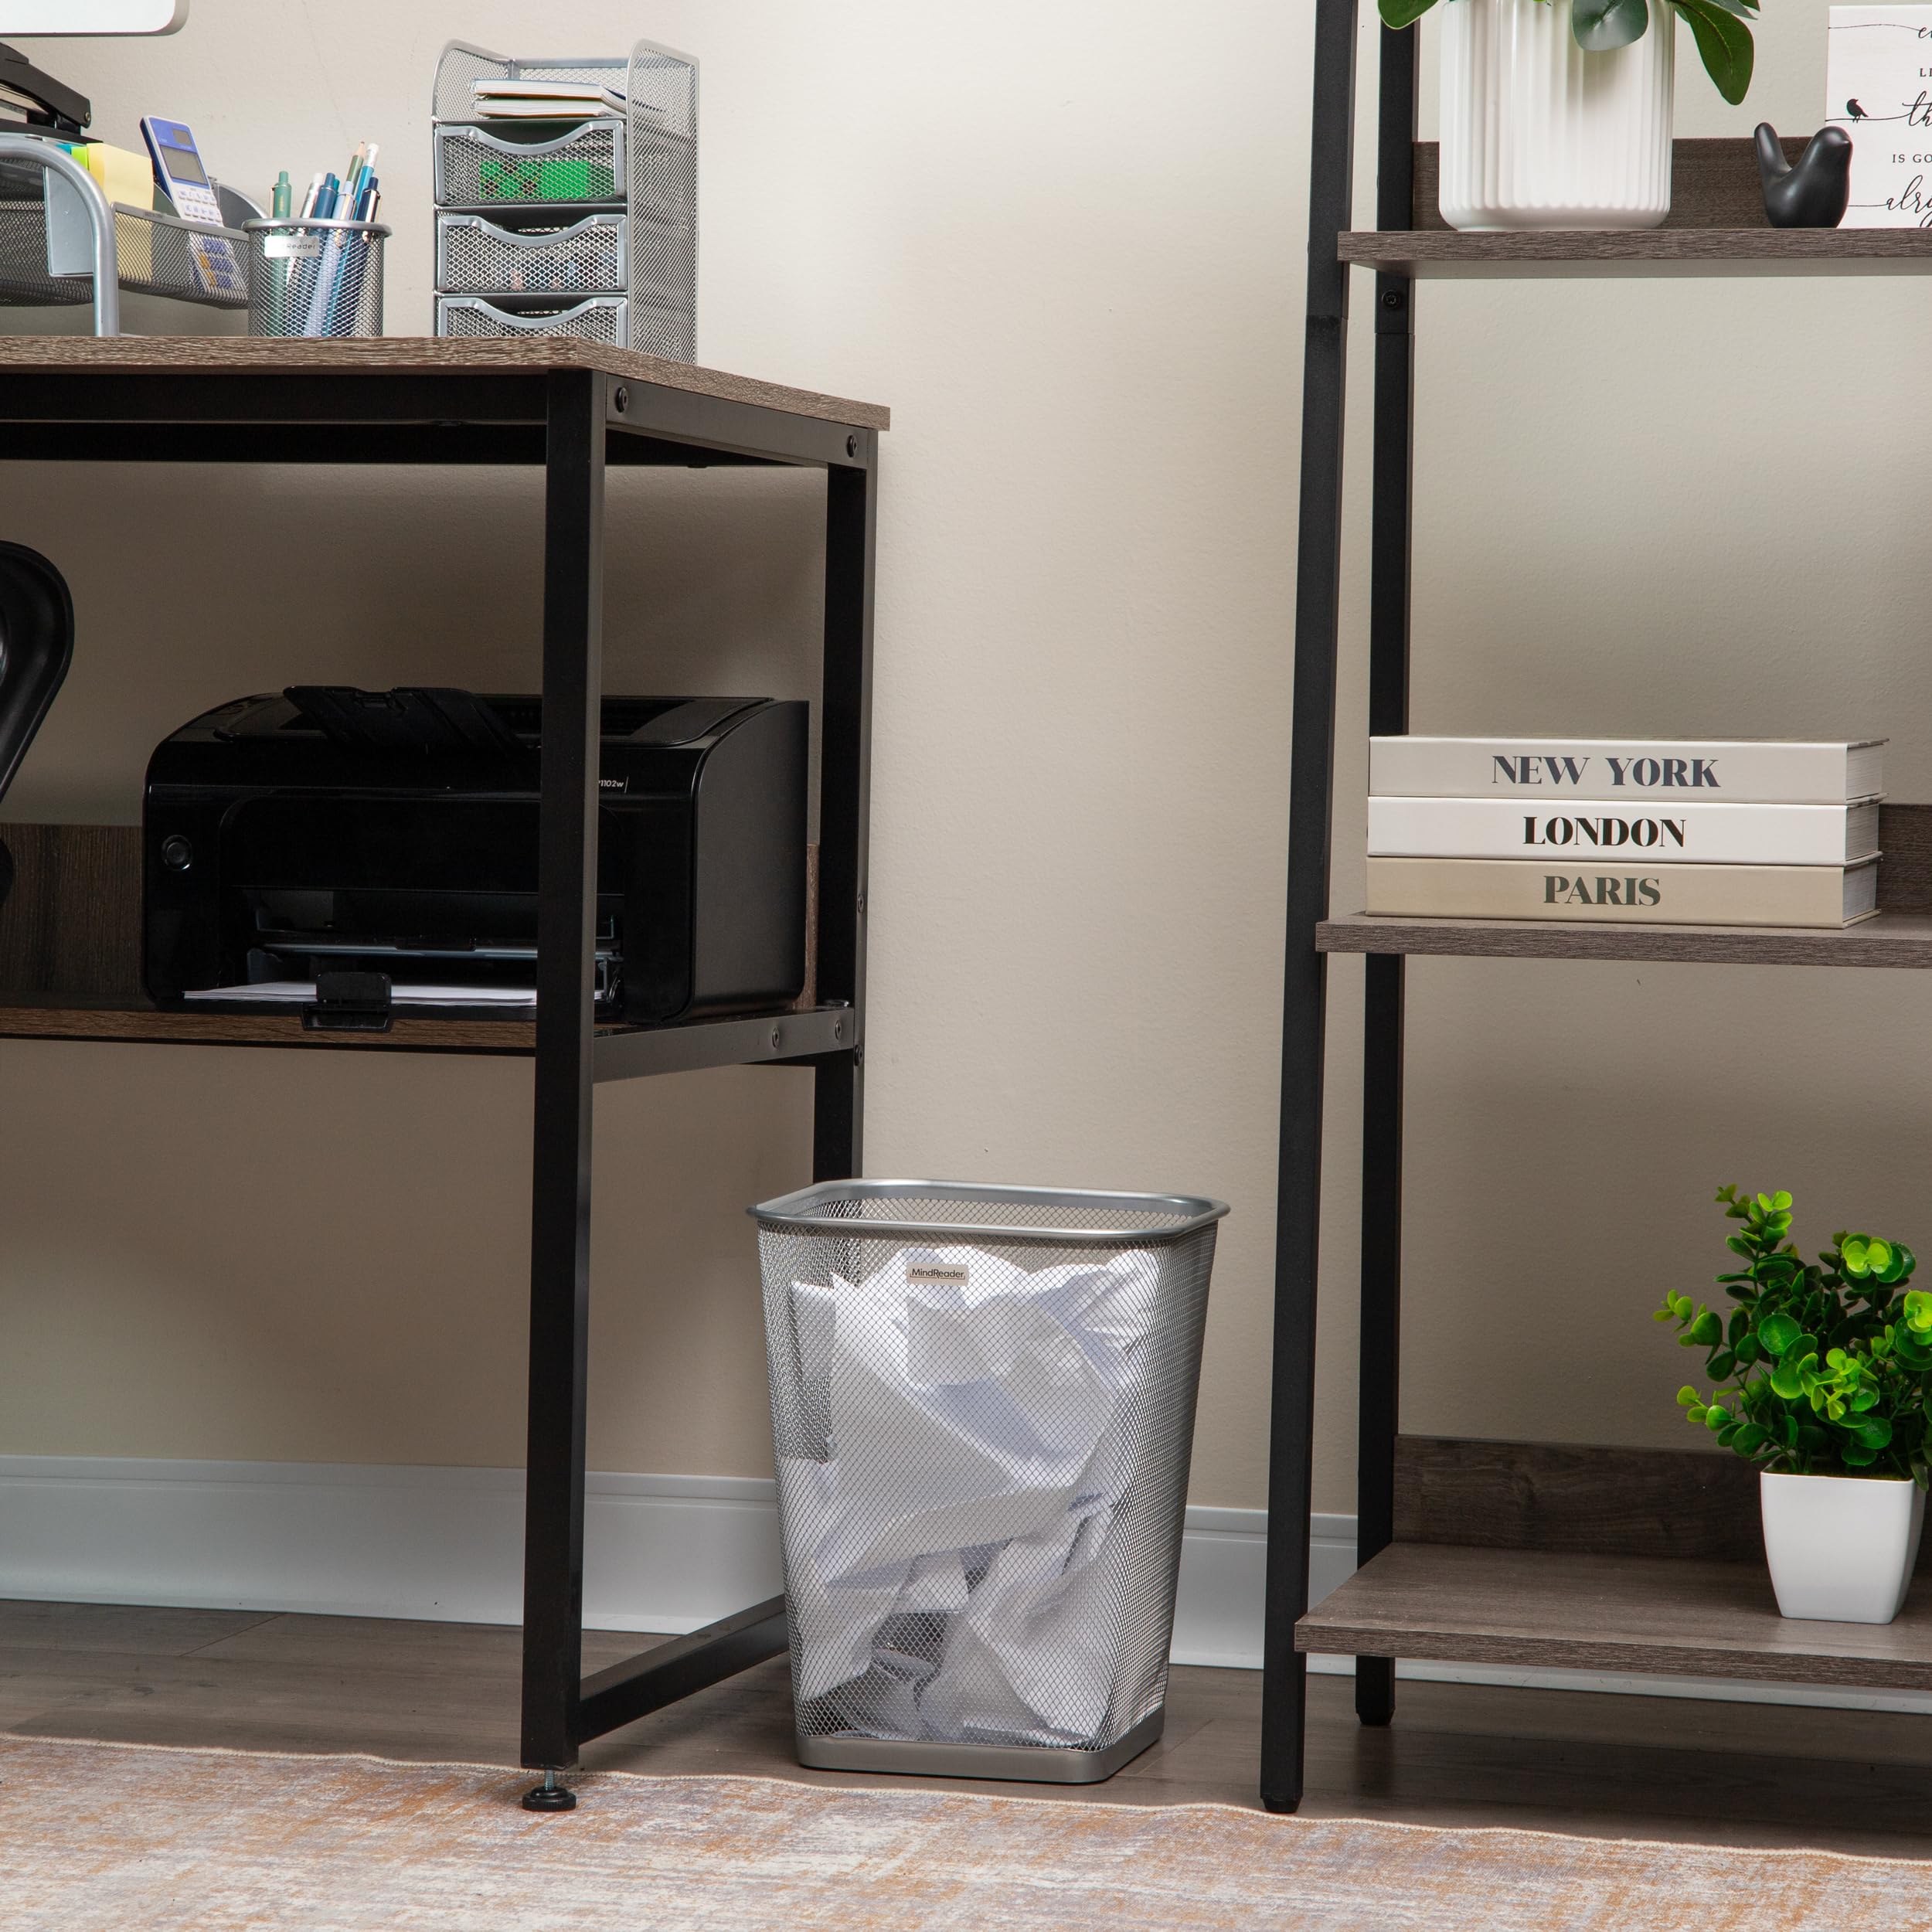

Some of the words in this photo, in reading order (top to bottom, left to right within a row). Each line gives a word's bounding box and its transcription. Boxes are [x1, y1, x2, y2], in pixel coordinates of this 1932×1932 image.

[1893, 154, 1905, 163] IS
[1492, 756, 1590, 784] NEW
[1605, 758, 1720, 787] YORK
[1524, 817, 1685, 847] LONDON
[1544, 876, 1661, 906] PARIS
[912, 1268, 964, 1279] MindReader
